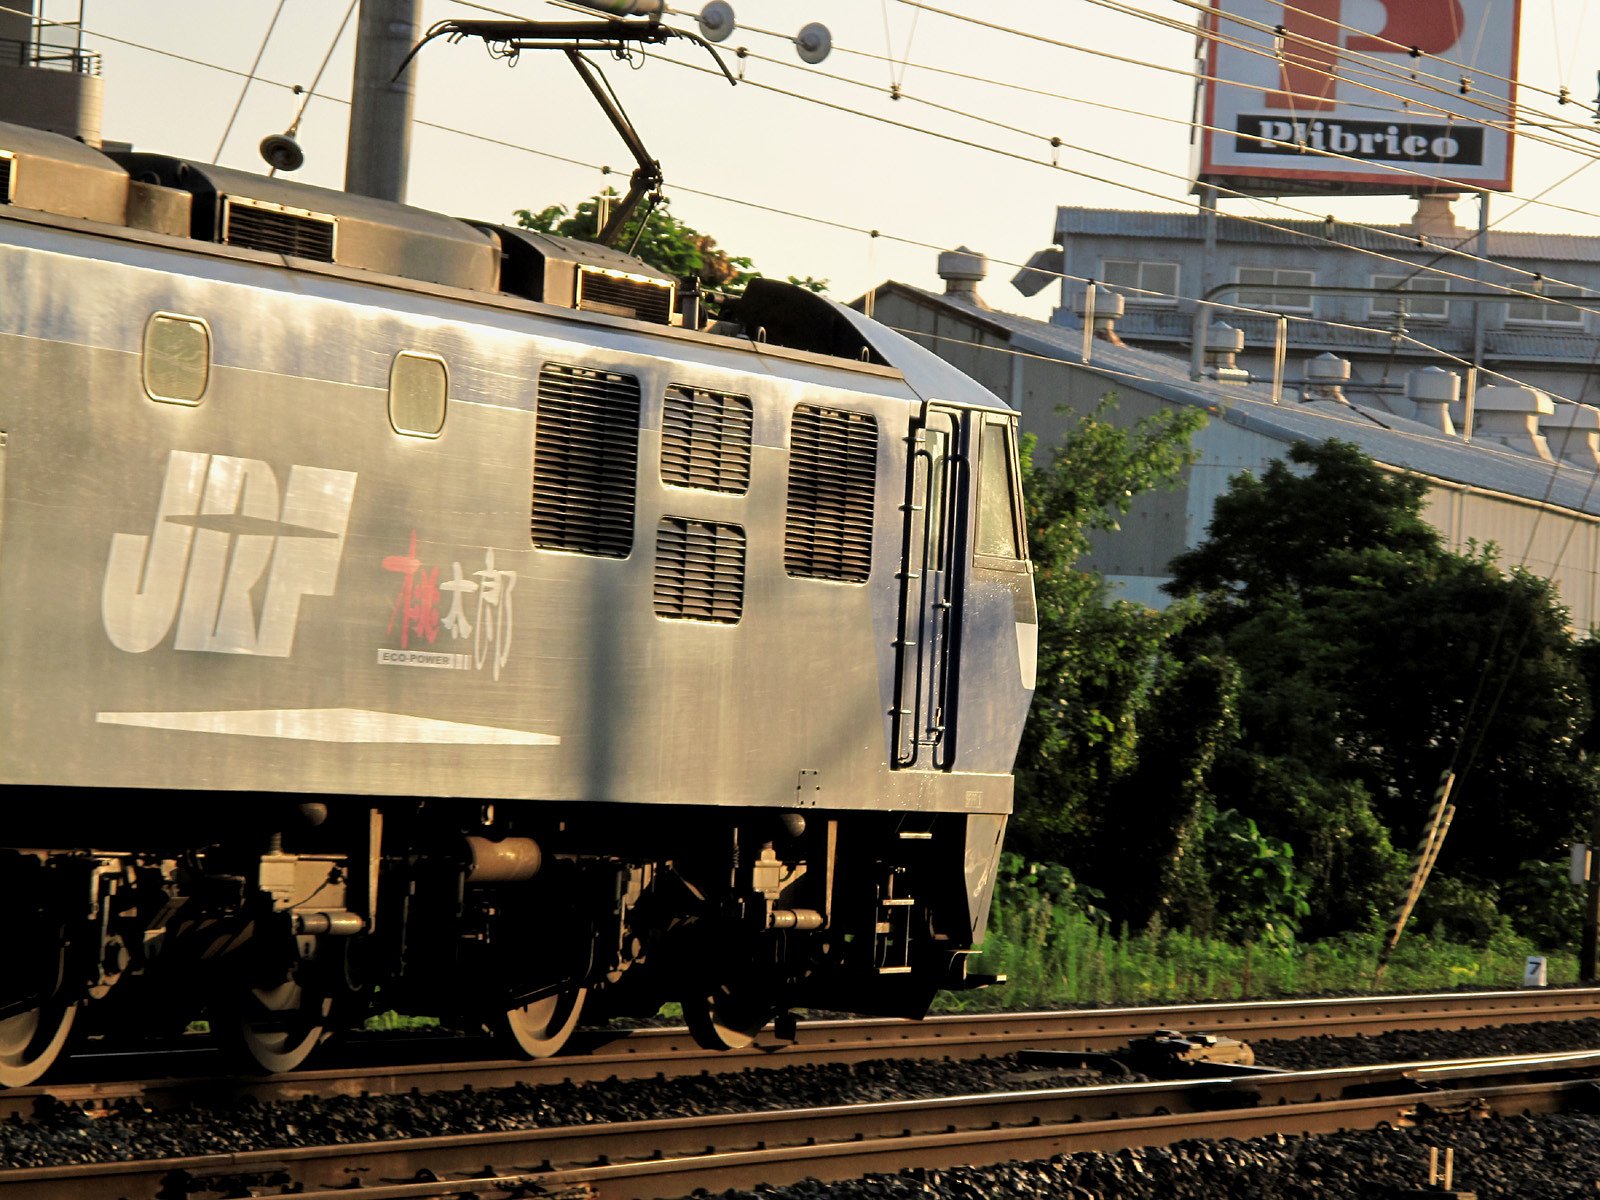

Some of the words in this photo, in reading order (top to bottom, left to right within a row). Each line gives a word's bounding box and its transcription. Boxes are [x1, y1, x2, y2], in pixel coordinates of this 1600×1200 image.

[1259, 120, 1459, 158] Plibrico
[102, 450, 358, 657] JRF
[383, 652, 450, 665] ECO-POWER
[1529, 961, 1541, 975] 7
